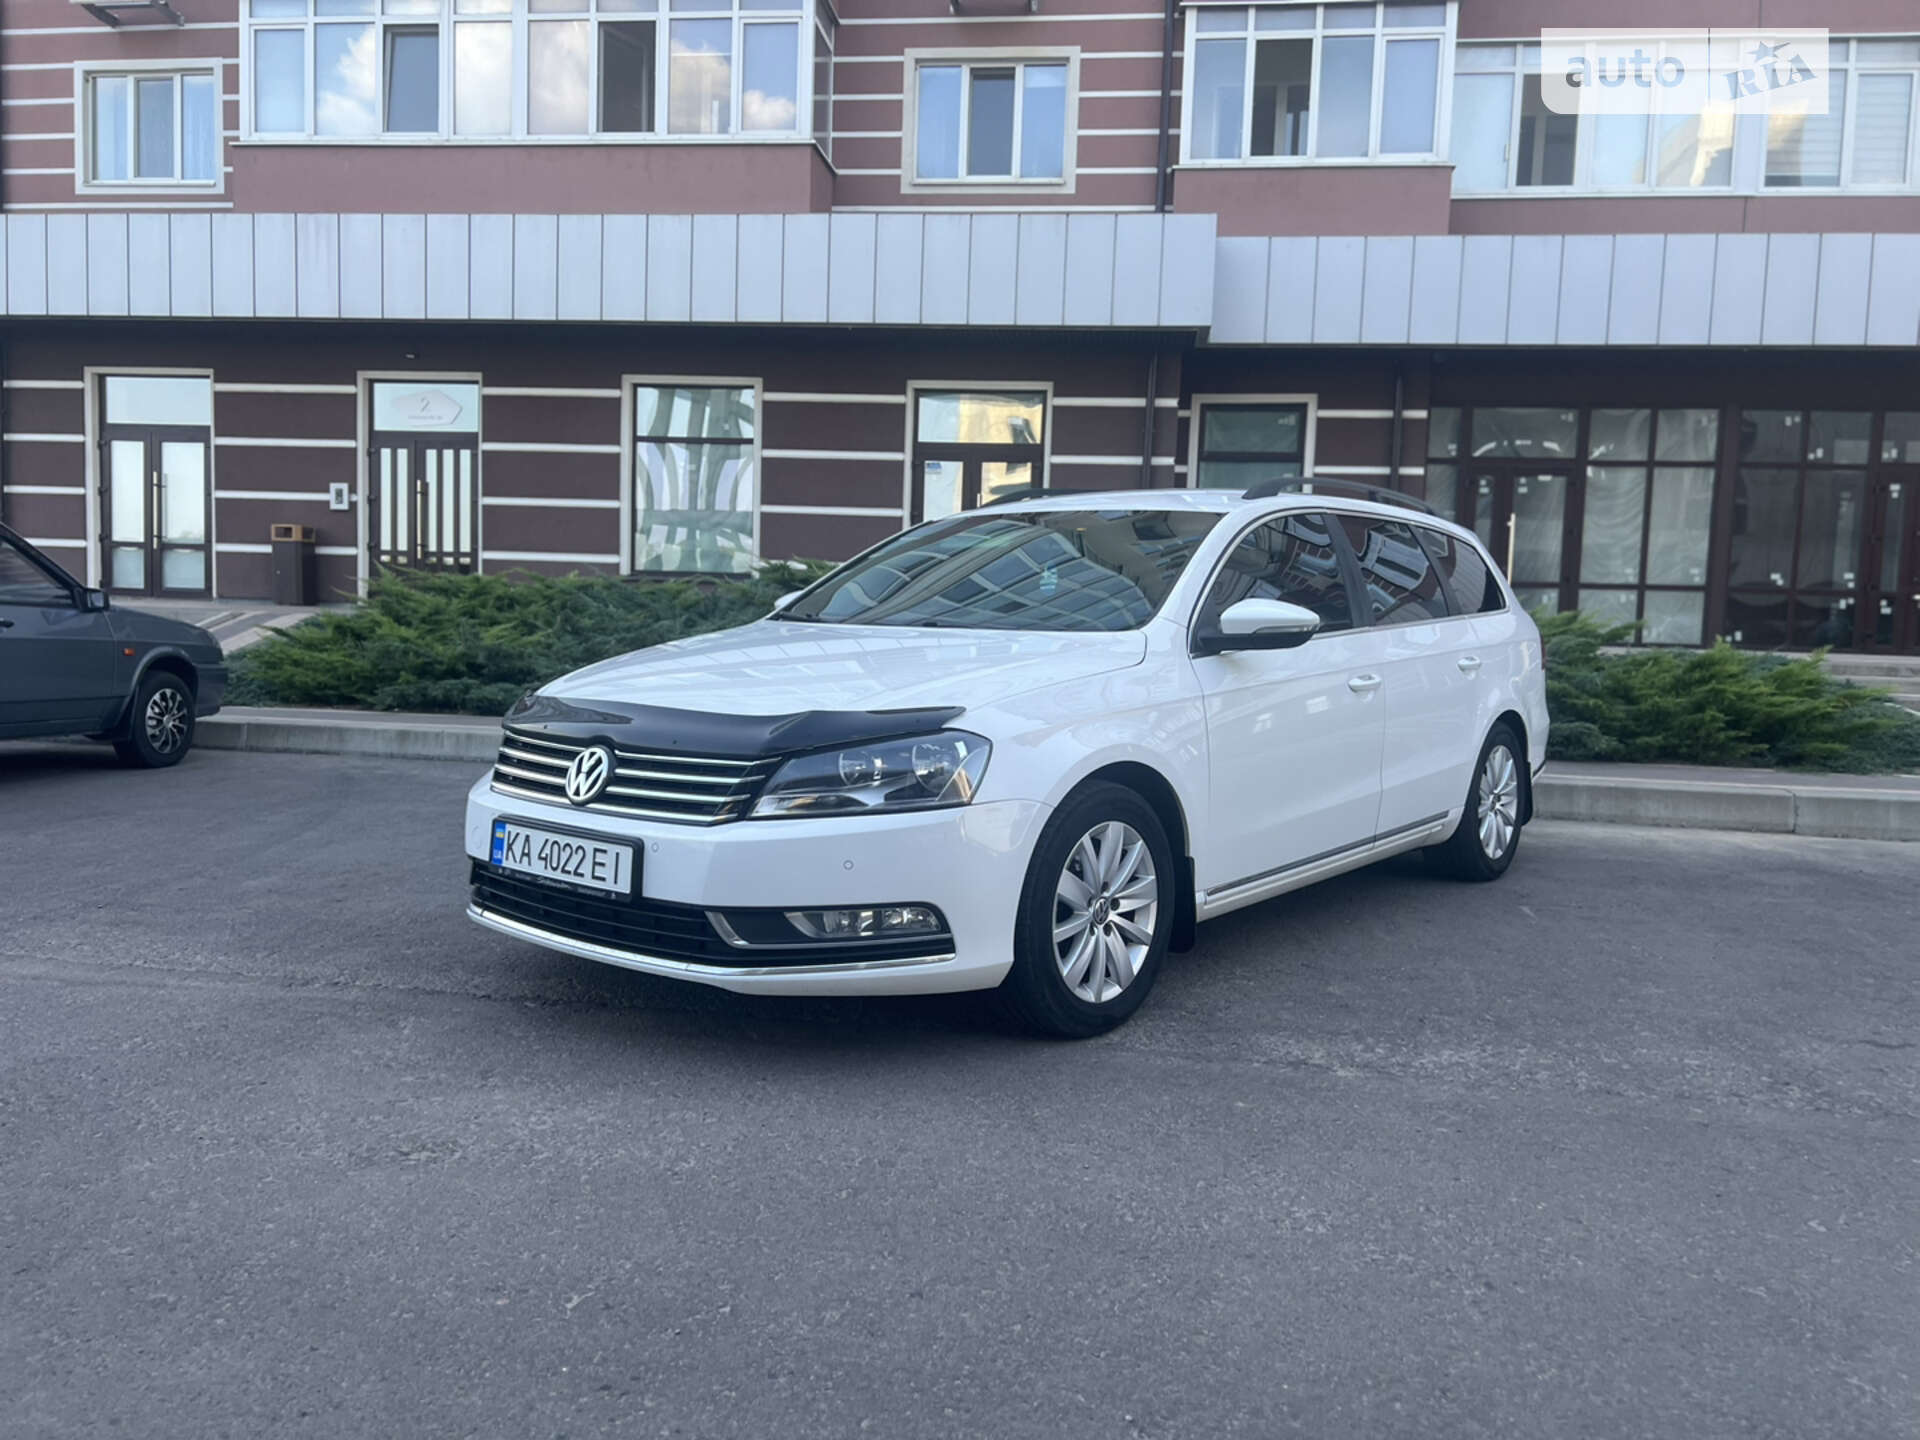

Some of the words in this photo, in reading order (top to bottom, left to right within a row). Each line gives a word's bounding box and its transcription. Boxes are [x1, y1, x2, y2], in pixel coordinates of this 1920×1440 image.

[506, 830, 532, 866] KA
[537, 838, 586, 878] 4022
[591, 847, 620, 885] EI
